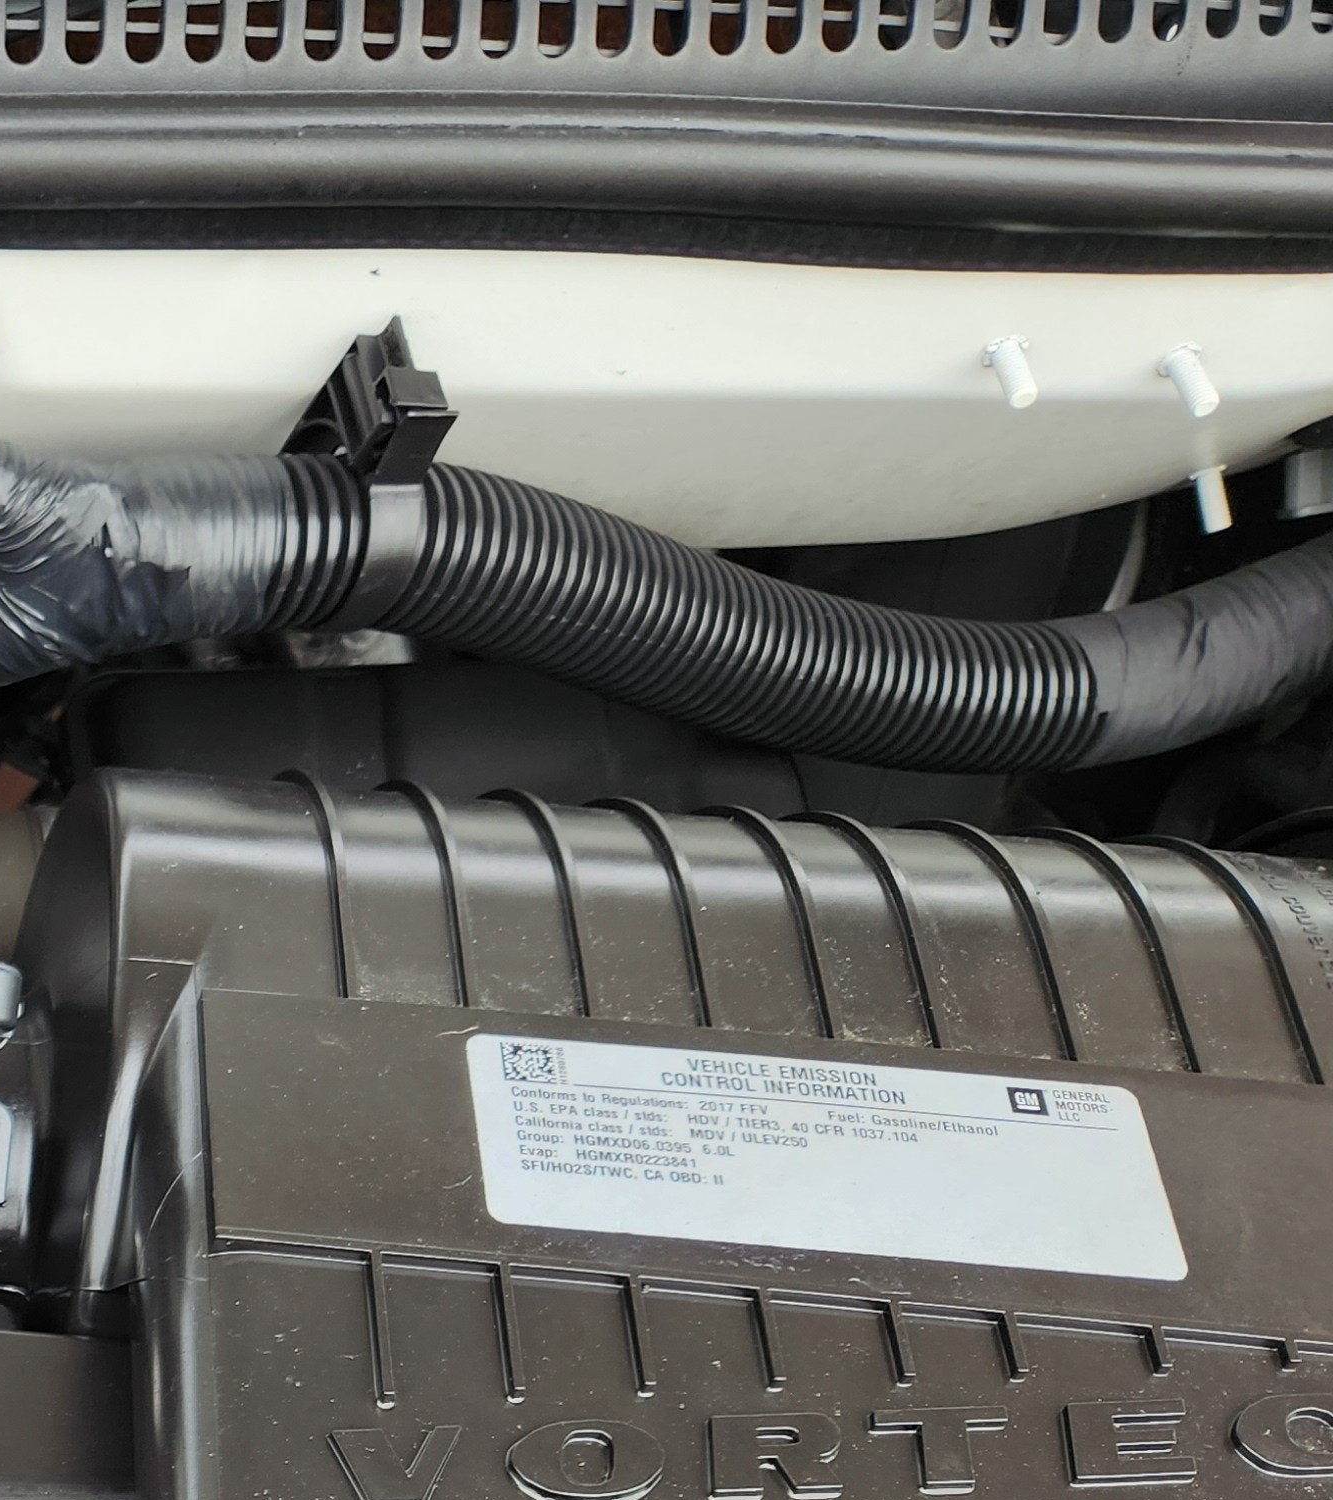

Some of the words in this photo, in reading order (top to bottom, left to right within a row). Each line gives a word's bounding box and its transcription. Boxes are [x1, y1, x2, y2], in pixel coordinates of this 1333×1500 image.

[687, 1058, 770, 1077] VEHICLE
[779, 1066, 877, 1086] EMISSION
[662, 1072, 756, 1091] CONTROL
[764, 1080, 907, 1105] INFORMATION
[1053, 1090, 1110, 1103] GENERAL
[511, 1086, 577, 1101] Conforms
[583, 1092, 595, 1103] to
[602, 1093, 689, 1110] Regulations:
[699, 1101, 733, 1112] 2017
[740, 1104, 768, 1115] FFV
[828, 1111, 865, 1124] Fuel:
[872, 1115, 999, 1137] Gasoline/Ethanol
[1055, 1101, 1108, 1113] MOTORS
[1059, 1112, 1080, 1122] LLC
[513, 1101, 543, 1113] U.S.
[550, 1104, 578, 1115] EPA
[584, 1107, 618, 1119] class
[687, 1114, 719, 1125] HDV
[792, 1123, 809, 1134] 40
[815, 1124, 844, 1137] CFR
[852, 1127, 919, 1143] 1037.104
[515, 1116, 583, 1130] California
[589, 1122, 623, 1133] class
[690, 1128, 724, 1140] MDV
[742, 1132, 808, 1148] ULEV250
[517, 1130, 564, 1144] Group:
[574, 1134, 692, 1154] HGMXD06.0395
[702, 1144, 735, 1156] 6.0L
[519, 1145, 558, 1158] Evap:
[644, 1169, 664, 1181] CA
[670, 1171, 708, 1184] OBD:
